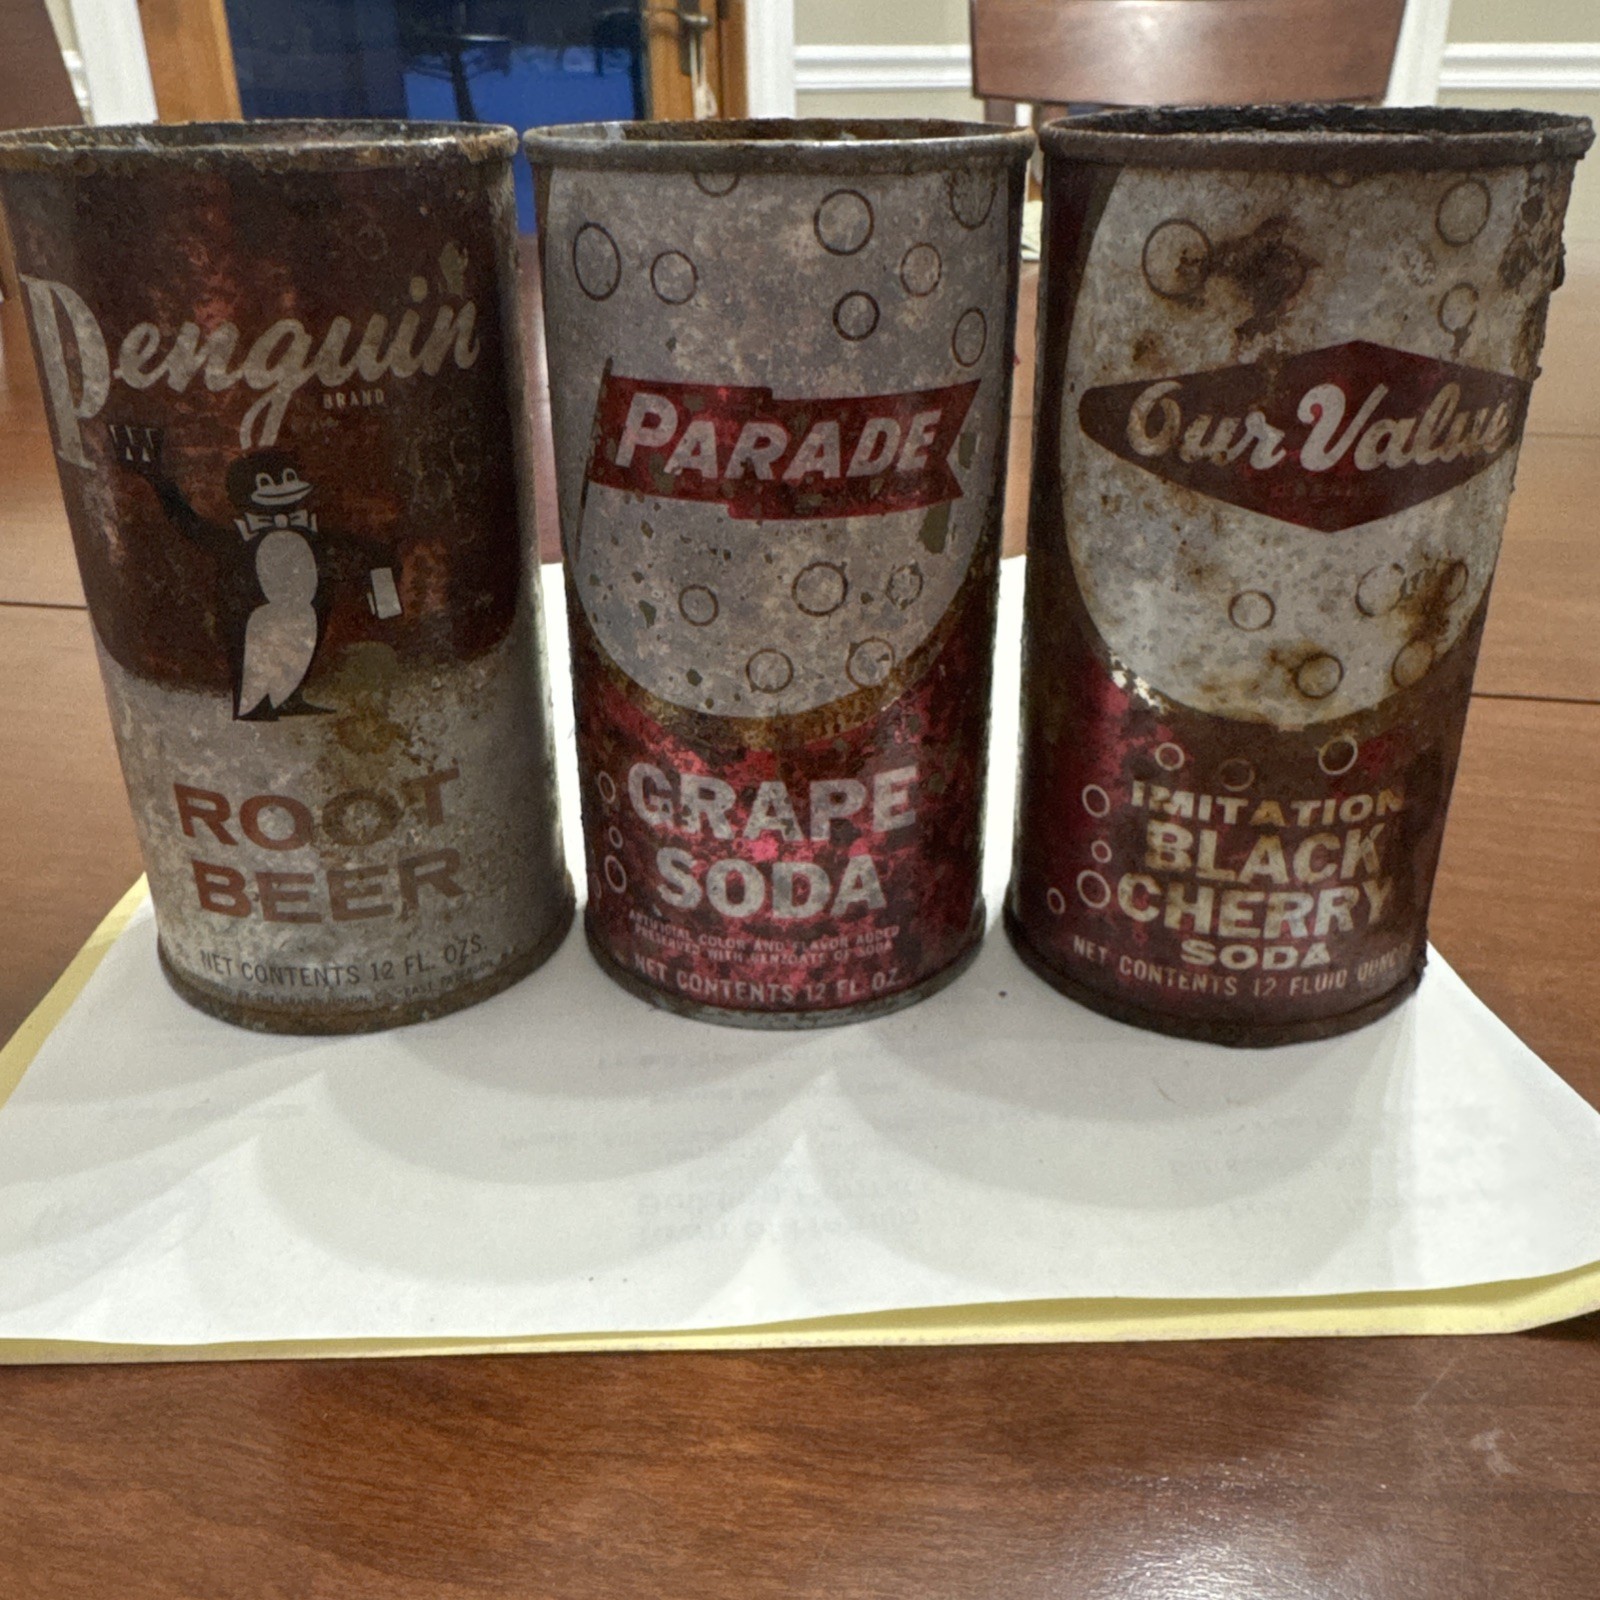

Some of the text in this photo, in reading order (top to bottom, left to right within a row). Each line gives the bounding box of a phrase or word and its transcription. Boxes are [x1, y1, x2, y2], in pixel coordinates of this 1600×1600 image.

[19, 273, 480, 470] Penguin
[322, 387, 386, 410] BRAND
[615, 392, 942, 481] PARADE
[1126, 380, 1510, 472] Our Value
[173, 767, 460, 851] ROOT
[628, 763, 918, 841] GRAPE
[1132, 780, 1405, 827] IMITATION
[656, 847, 887, 919] SODA
[1145, 821, 1386, 884] BLACK
[191, 848, 466, 924] BEER
[1118, 872, 1394, 939] CHERRY
[200, 949, 232, 976] NET
[241, 961, 361, 986] CONTENTS
[371, 959, 394, 982] 12
[404, 949, 436, 977] FL.
[698, 934, 746, 950] COLOR
[753, 940, 784, 952] AND
[1073, 934, 1109, 965] NET
[1119, 953, 1238, 997] CONTENTS
[1253, 976, 1278, 998] 12
[1290, 968, 1348, 997] FLUID
[1181, 939, 1331, 971] SODA
[634, 952, 668, 983] NET
[676, 969, 794, 1003] CONTENTS
[805, 983, 826, 1002] 12
